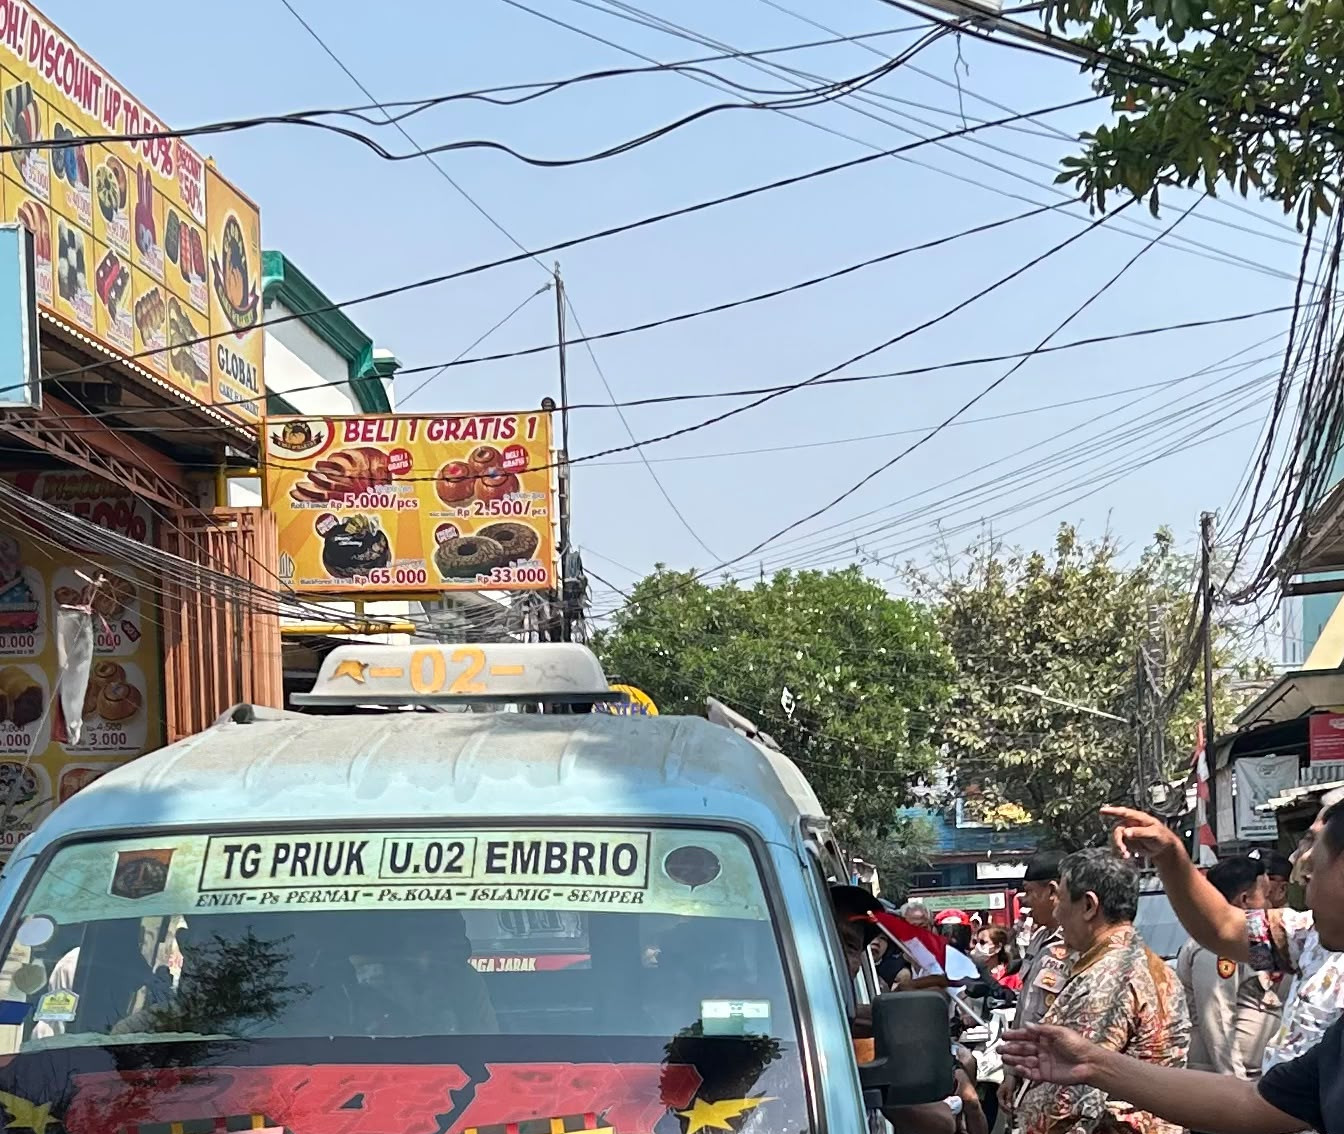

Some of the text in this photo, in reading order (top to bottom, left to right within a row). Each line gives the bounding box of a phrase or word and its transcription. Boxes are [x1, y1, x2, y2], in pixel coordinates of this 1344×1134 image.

[29, 19, 102, 116] DISCOUNT
[104, 83, 122, 131] UP
[123, 101, 139, 146] TO
[216, 343, 260, 394] GLOBAL
[343, 416, 536, 443] BELI 1 GRATIS 1
[331, 499, 343, 511] Rp
[457, 508, 471, 519] Rp
[354, 575, 368, 586] Rp
[369, 568, 428, 585] 65.000
[477, 574, 490, 585] Rp
[492, 568, 547, 584] 33.000
[90, 732, 127, 746] 3.000
[223, 840, 639, 880] TG PRIUK U.02 EMBRIO
[286, 889, 360, 905] PERMAI
[567, 888, 645, 904] SEMPER
[467, 957, 537, 973] AGA JARAK
